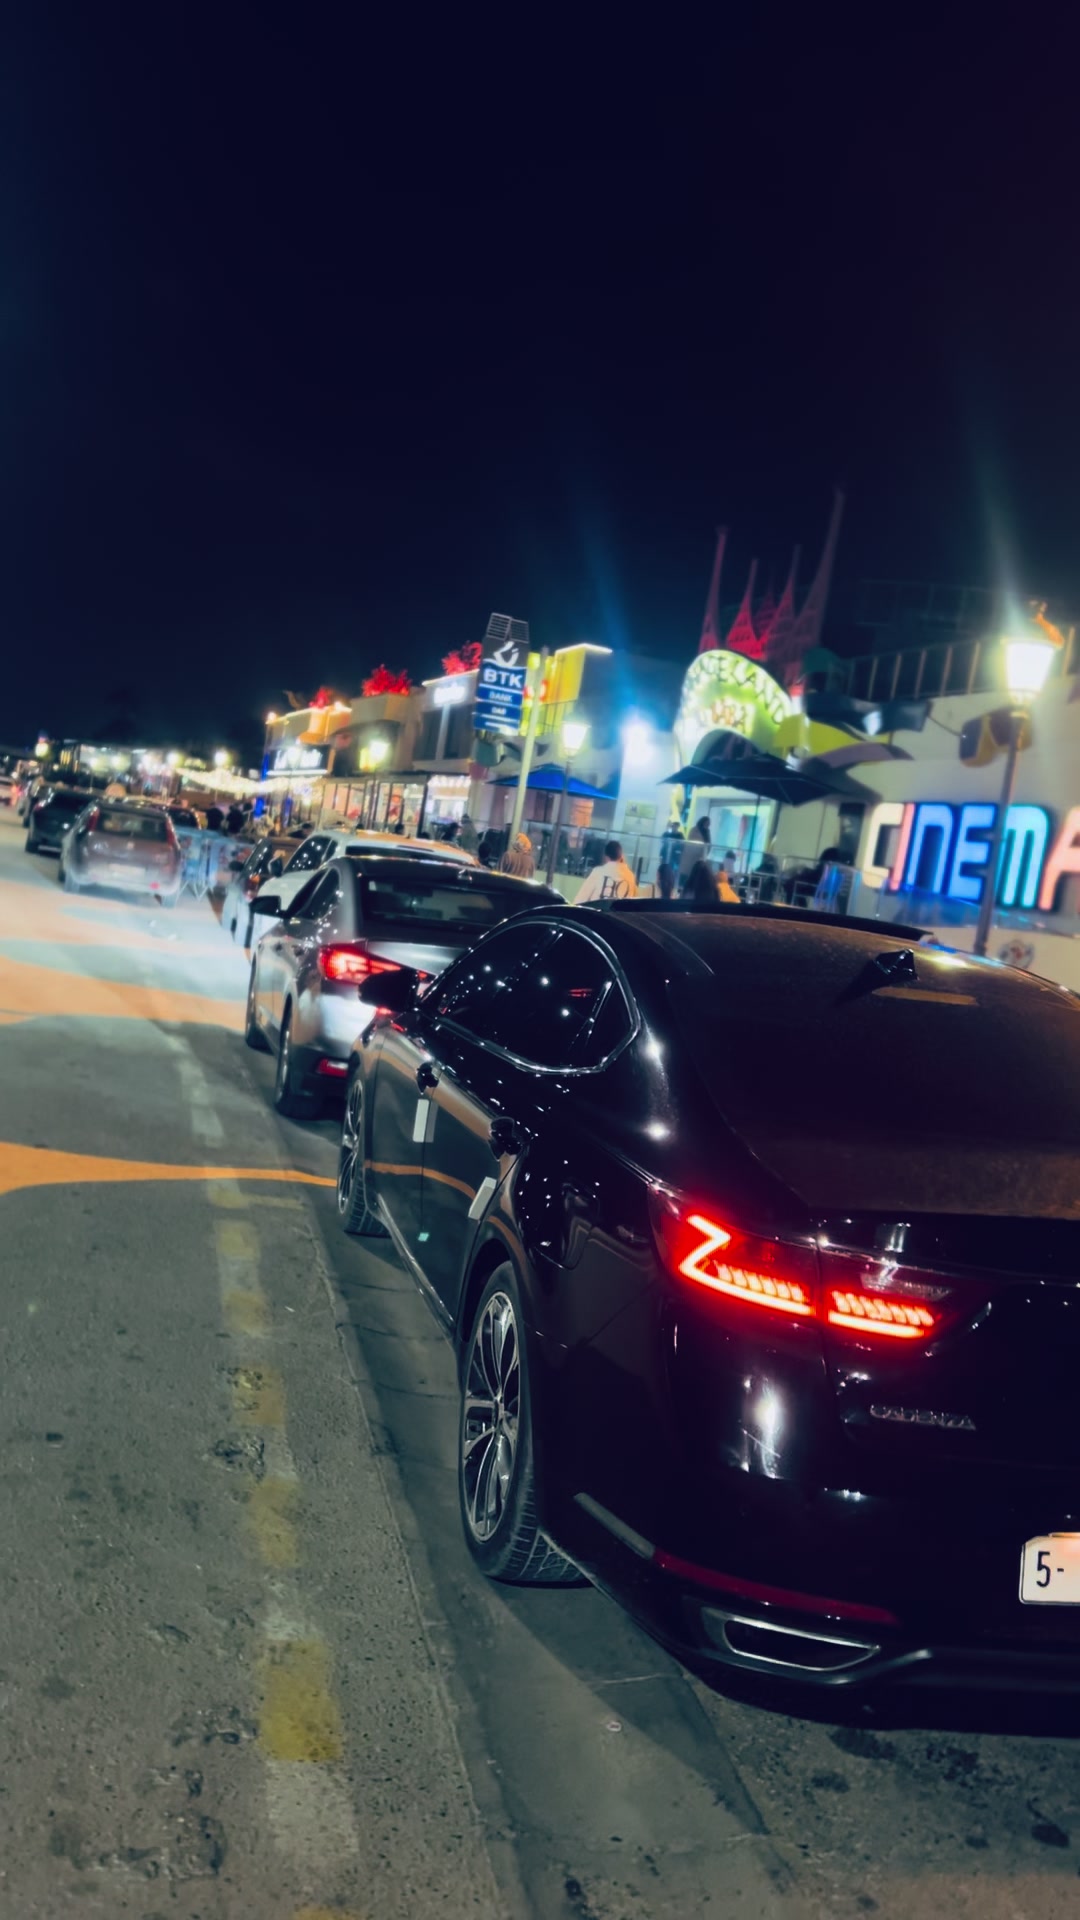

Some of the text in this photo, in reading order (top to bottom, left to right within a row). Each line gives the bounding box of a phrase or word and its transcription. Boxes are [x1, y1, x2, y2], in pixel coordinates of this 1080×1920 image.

[483, 668, 523, 688] BTK
[863, 802, 1080, 910] CINEMA
[869, 1403, 976, 1431] CADENZA
